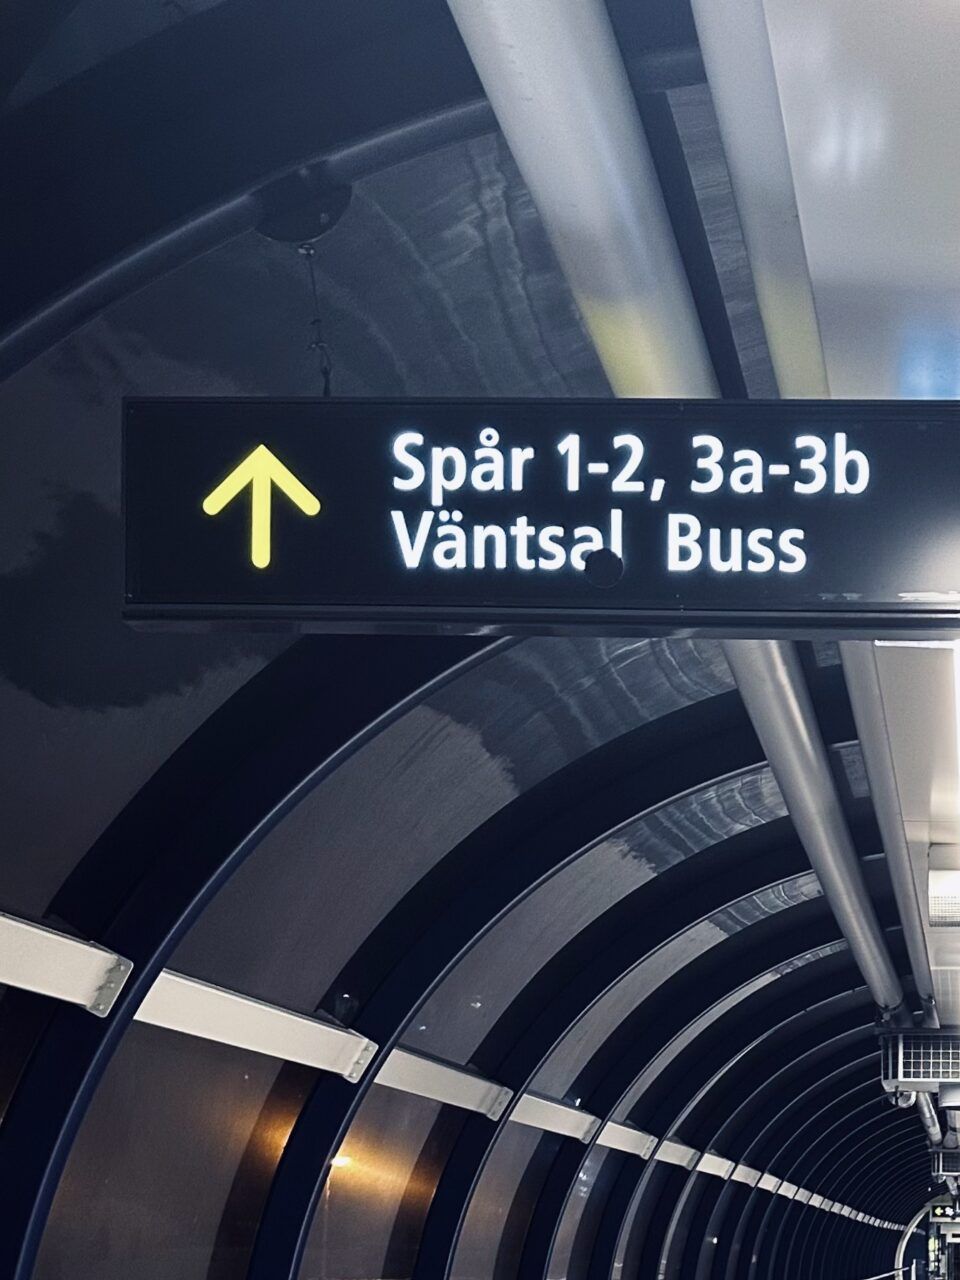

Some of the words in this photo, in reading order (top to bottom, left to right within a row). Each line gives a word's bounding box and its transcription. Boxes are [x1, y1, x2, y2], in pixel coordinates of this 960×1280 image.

[391, 427, 535, 507] Spår
[556, 433, 667, 502] 1-2,
[690, 432, 871, 495] 3a-3b
[667, 513, 807, 574] Buss
